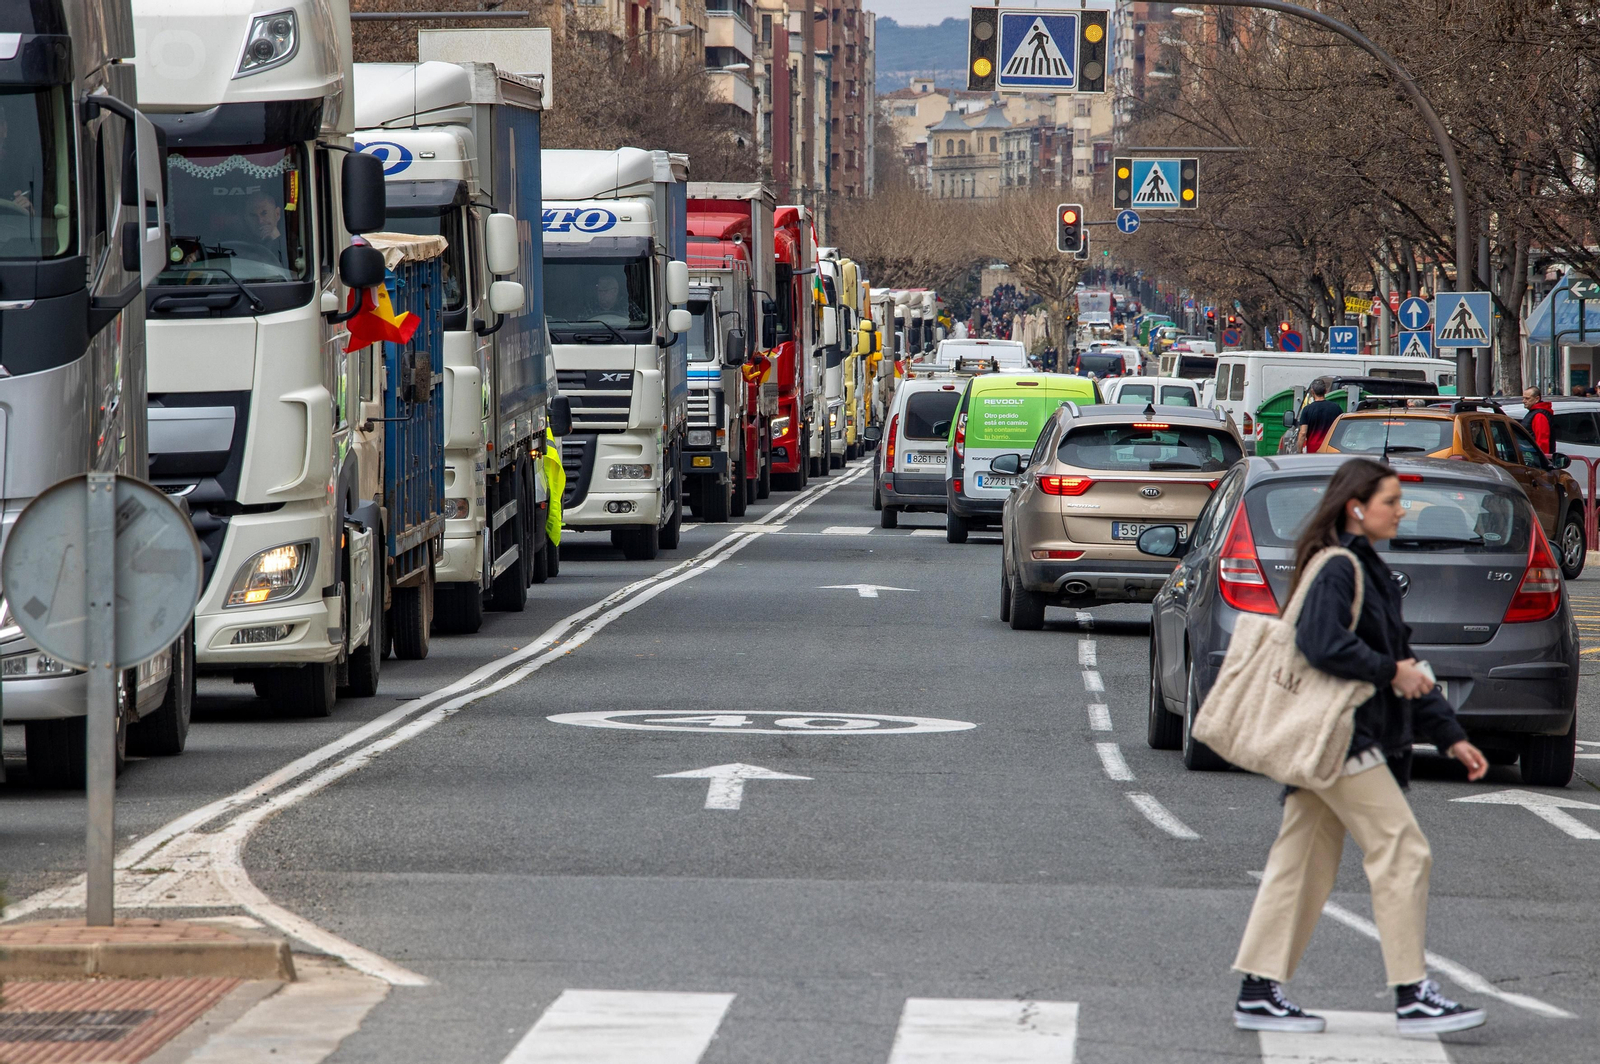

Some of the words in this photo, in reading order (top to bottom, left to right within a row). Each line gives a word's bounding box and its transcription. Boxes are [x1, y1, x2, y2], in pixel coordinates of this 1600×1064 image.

[213, 185, 261, 196] DAF
[542, 207, 618, 233] TO
[1334, 332, 1353, 343] VP
[599, 373, 631, 382] XF
[998, 412, 1019, 420] pedido
[913, 455, 931, 463] 8261
[984, 477, 1006, 486] 2778
[1487, 570, 1513, 582] i30
[644, 715, 880, 731] 40
